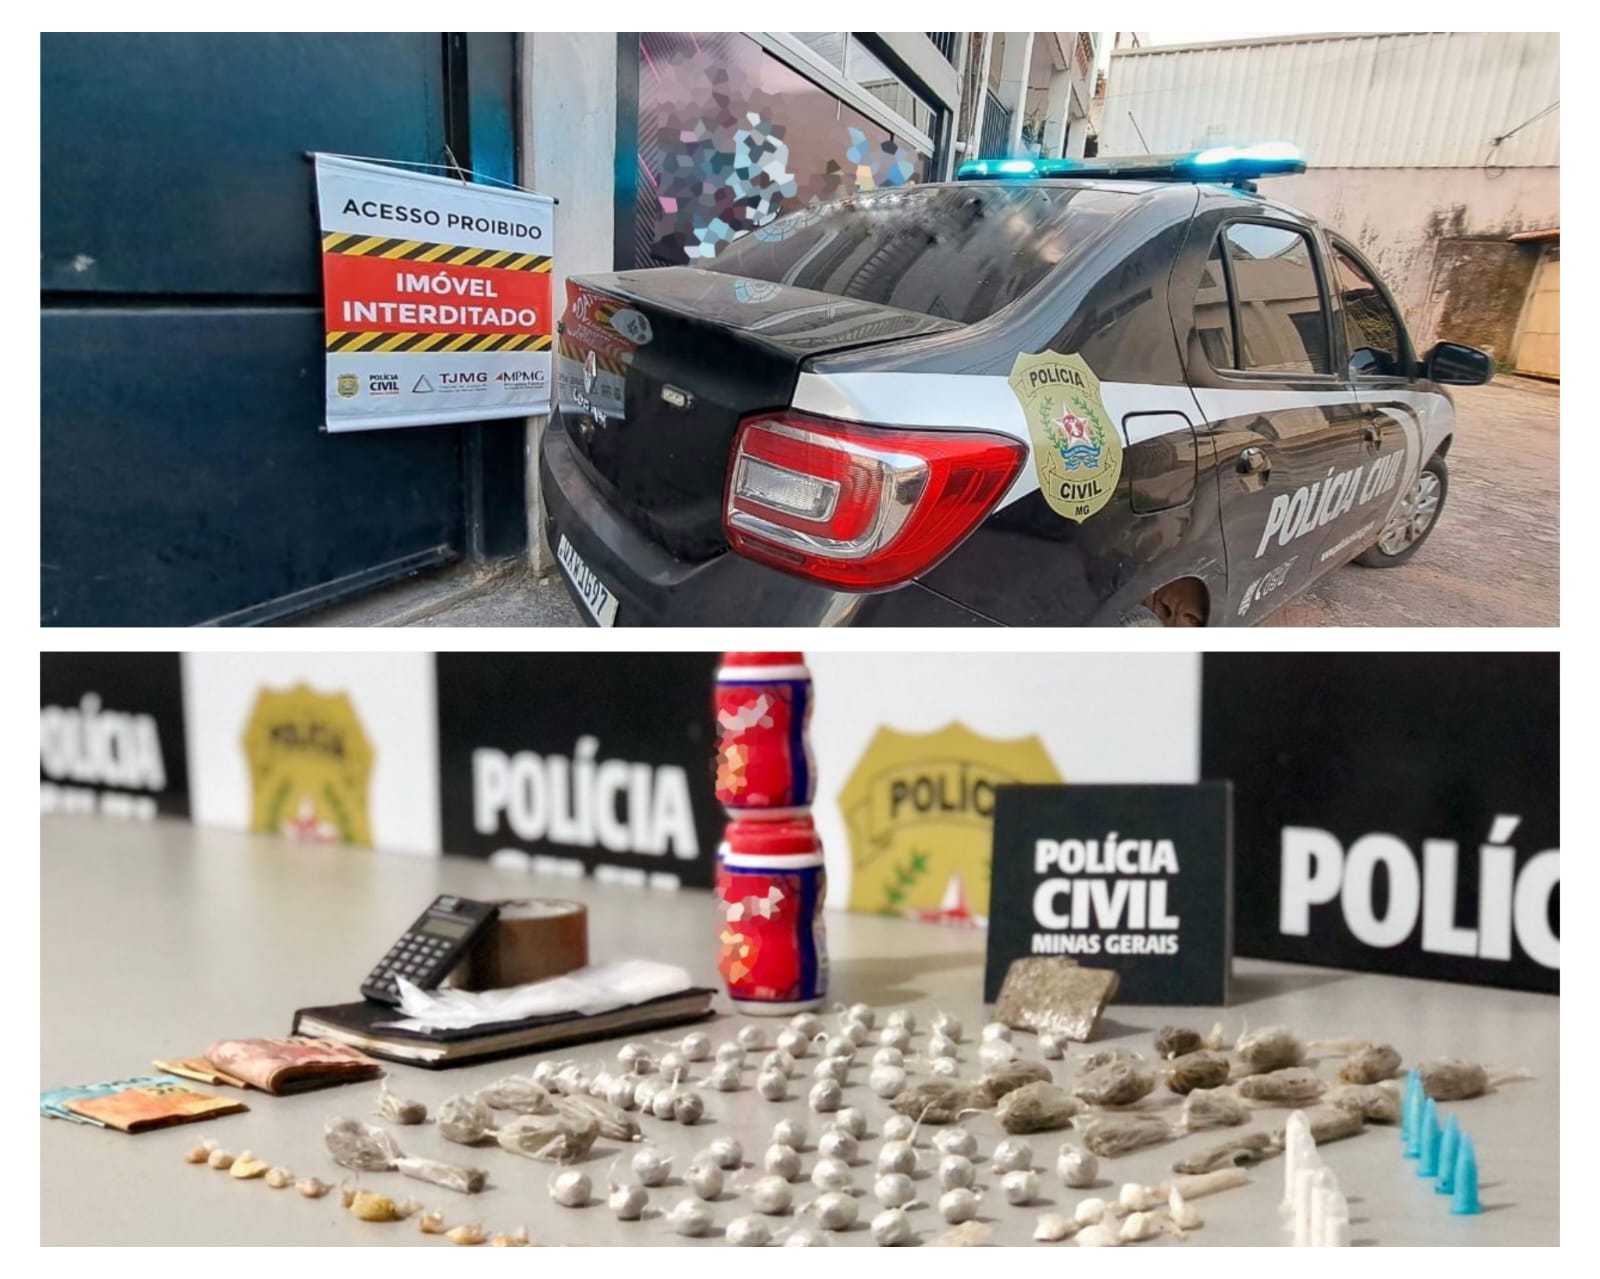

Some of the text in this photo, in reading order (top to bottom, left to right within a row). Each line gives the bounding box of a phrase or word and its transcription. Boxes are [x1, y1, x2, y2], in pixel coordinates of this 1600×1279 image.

[342, 199, 542, 240] ACESSO PROIBIDO
[396, 271, 498, 298] IMÓVEL
[343, 301, 536, 327] INTERDITADO
[370, 381, 399, 391] CIVIL
[438, 372, 488, 384] TJMG
[503, 370, 544, 382] MPMG
[1029, 363, 1085, 388] POLÍCIA
[1060, 480, 1102, 499] CIVIL
[1075, 505, 1090, 516] MG
[1255, 466, 1364, 559] POLÍCIA
[1359, 450, 1405, 505] CIVIL
[472, 735, 698, 860] POLÍCIA
[1034, 831, 1180, 874] POLÍCIA
[1032, 878, 1180, 930] CIVIL
[1031, 934, 1179, 955] MINAS GERAIS
